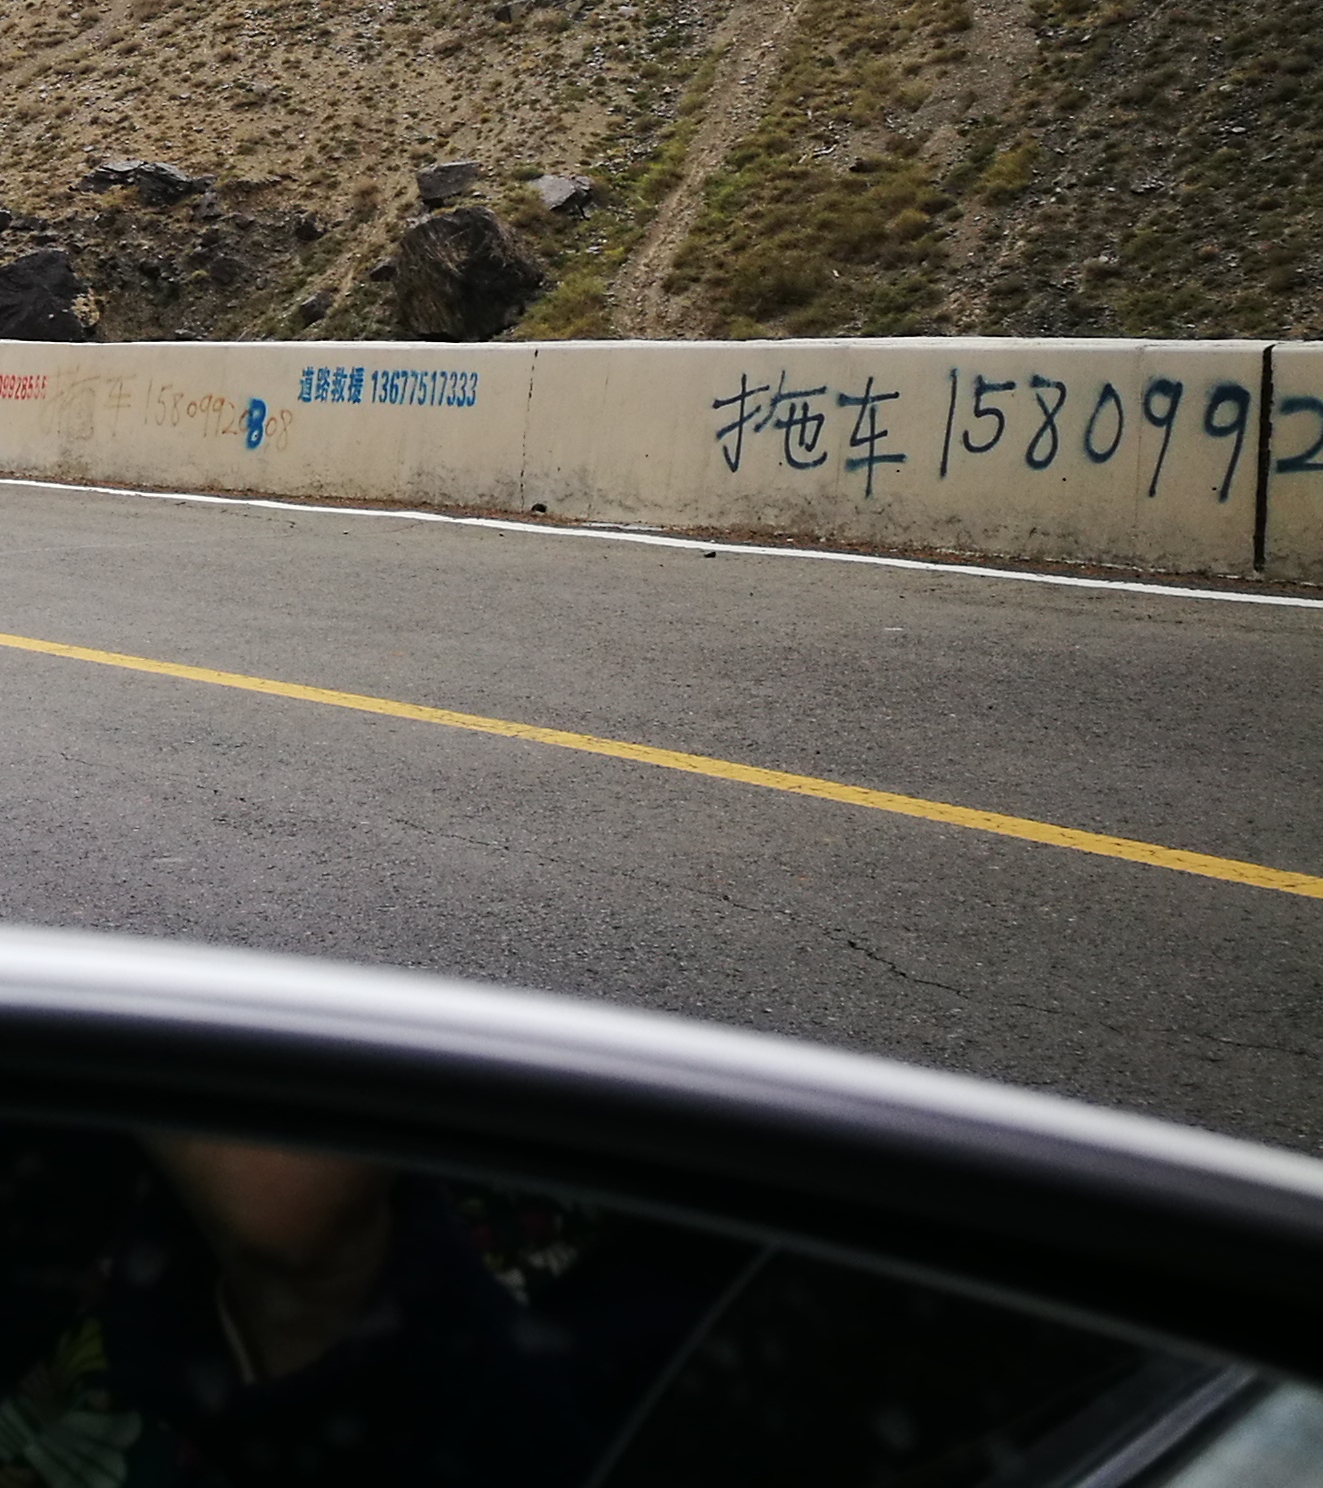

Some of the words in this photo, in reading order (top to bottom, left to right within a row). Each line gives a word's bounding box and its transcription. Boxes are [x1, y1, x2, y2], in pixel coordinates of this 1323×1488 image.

[297, 366, 365, 405] 道路救援
[371, 369, 479, 408] 13677517333
